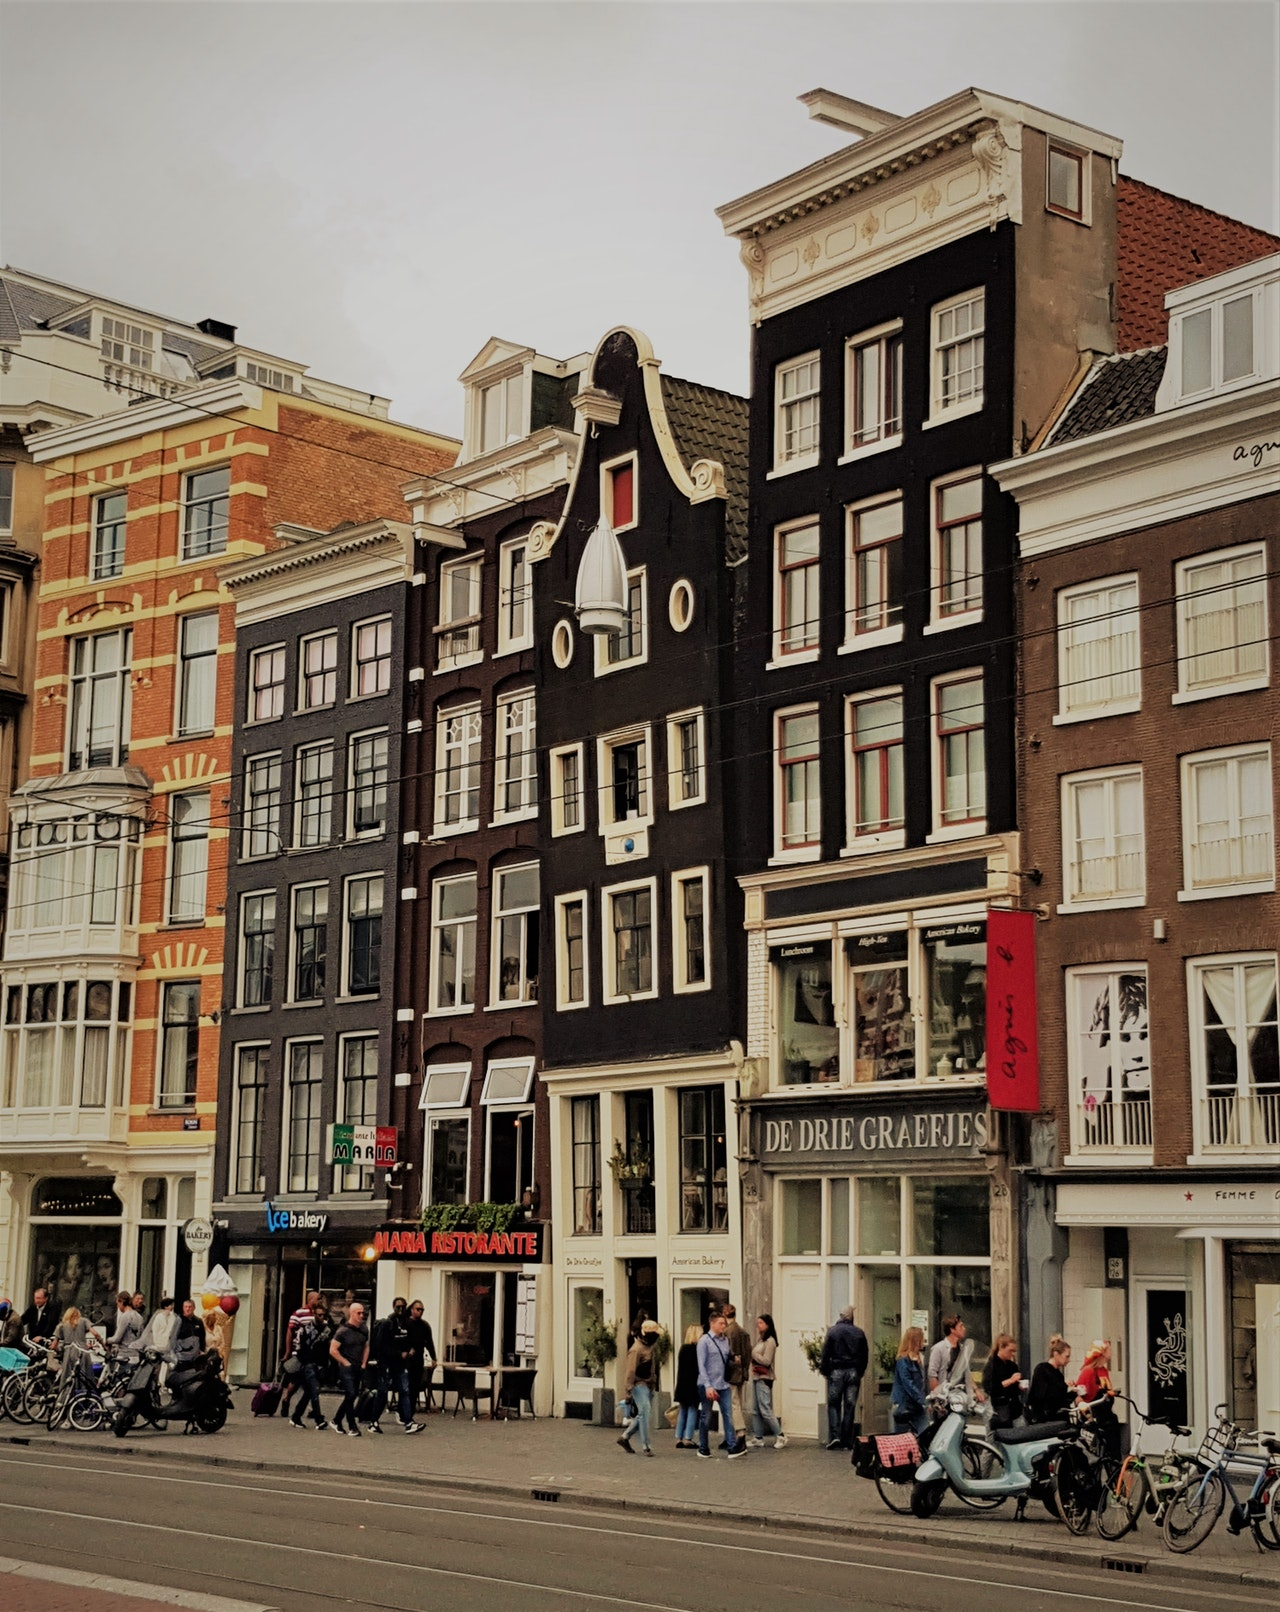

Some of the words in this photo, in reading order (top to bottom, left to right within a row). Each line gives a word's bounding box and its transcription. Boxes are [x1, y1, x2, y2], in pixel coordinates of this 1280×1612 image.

[956, 925, 982, 936] Bakery
[781, 946, 814, 957] Lunchroom
[765, 1120, 793, 1152] DE
[799, 1117, 855, 1151] DRIE
[859, 1112, 988, 1150] GRAEFJES
[333, 1143, 396, 1161] MARIA
[1215, 1191, 1256, 1200] FEMME
[290, 1210, 327, 1232] bakery
[374, 1231, 426, 1253] MARIA
[431, 1232, 537, 1255] RISTORANTE
[672, 1256, 700, 1266] American
[702, 1256, 726, 1268] Bakery
